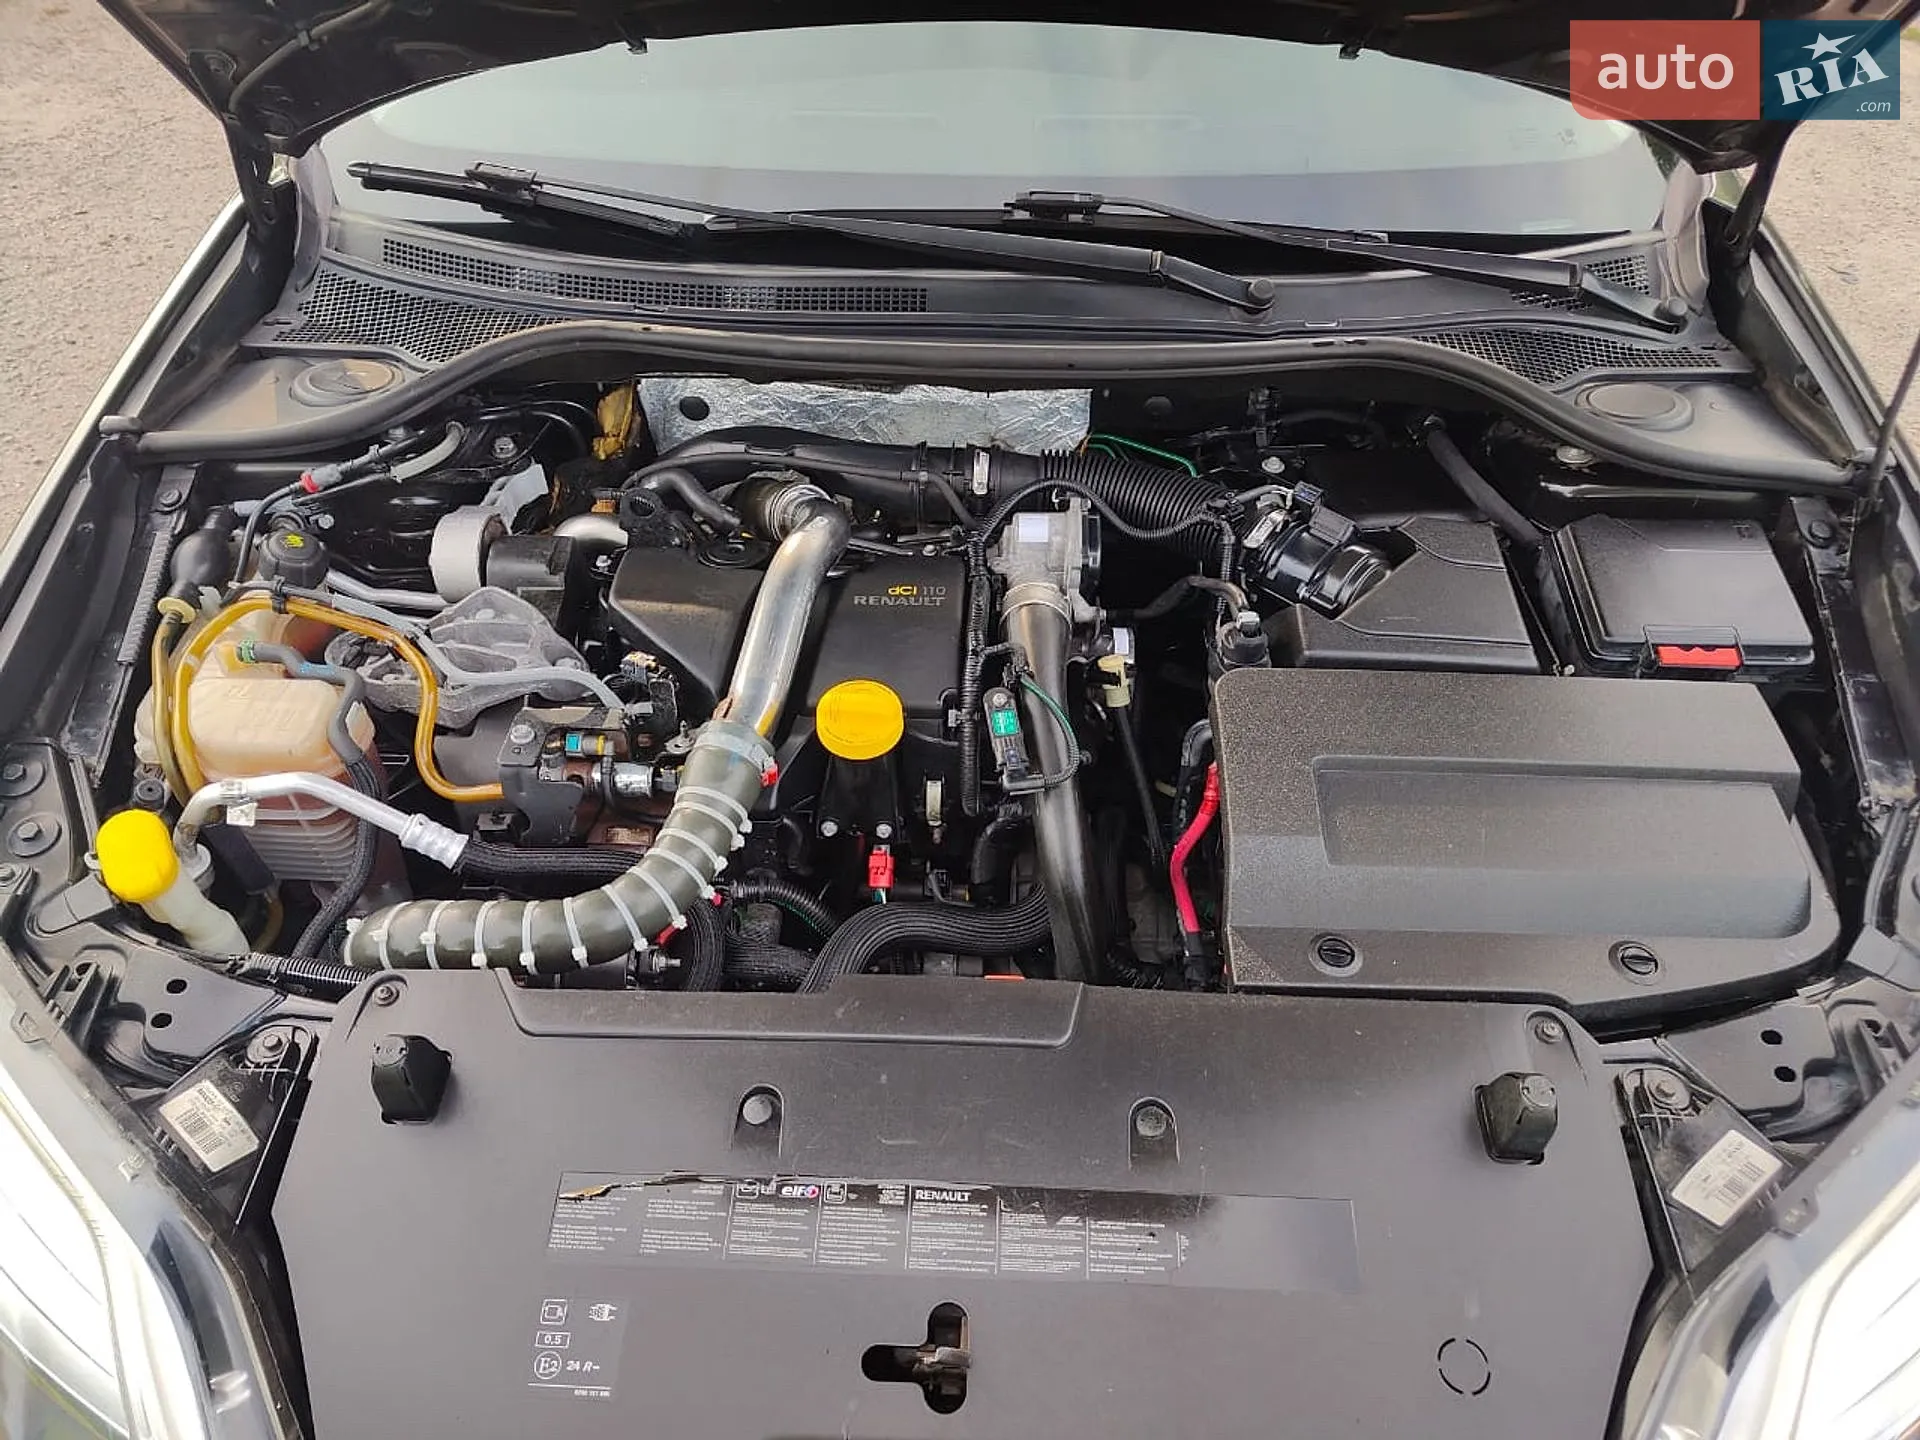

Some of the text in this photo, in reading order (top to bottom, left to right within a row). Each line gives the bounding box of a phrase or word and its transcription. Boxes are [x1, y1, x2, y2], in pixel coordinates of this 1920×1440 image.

[923, 586, 946, 595] 110
[854, 596, 946, 606] RENAULT
[915, 1189, 972, 1201] RENAULT
